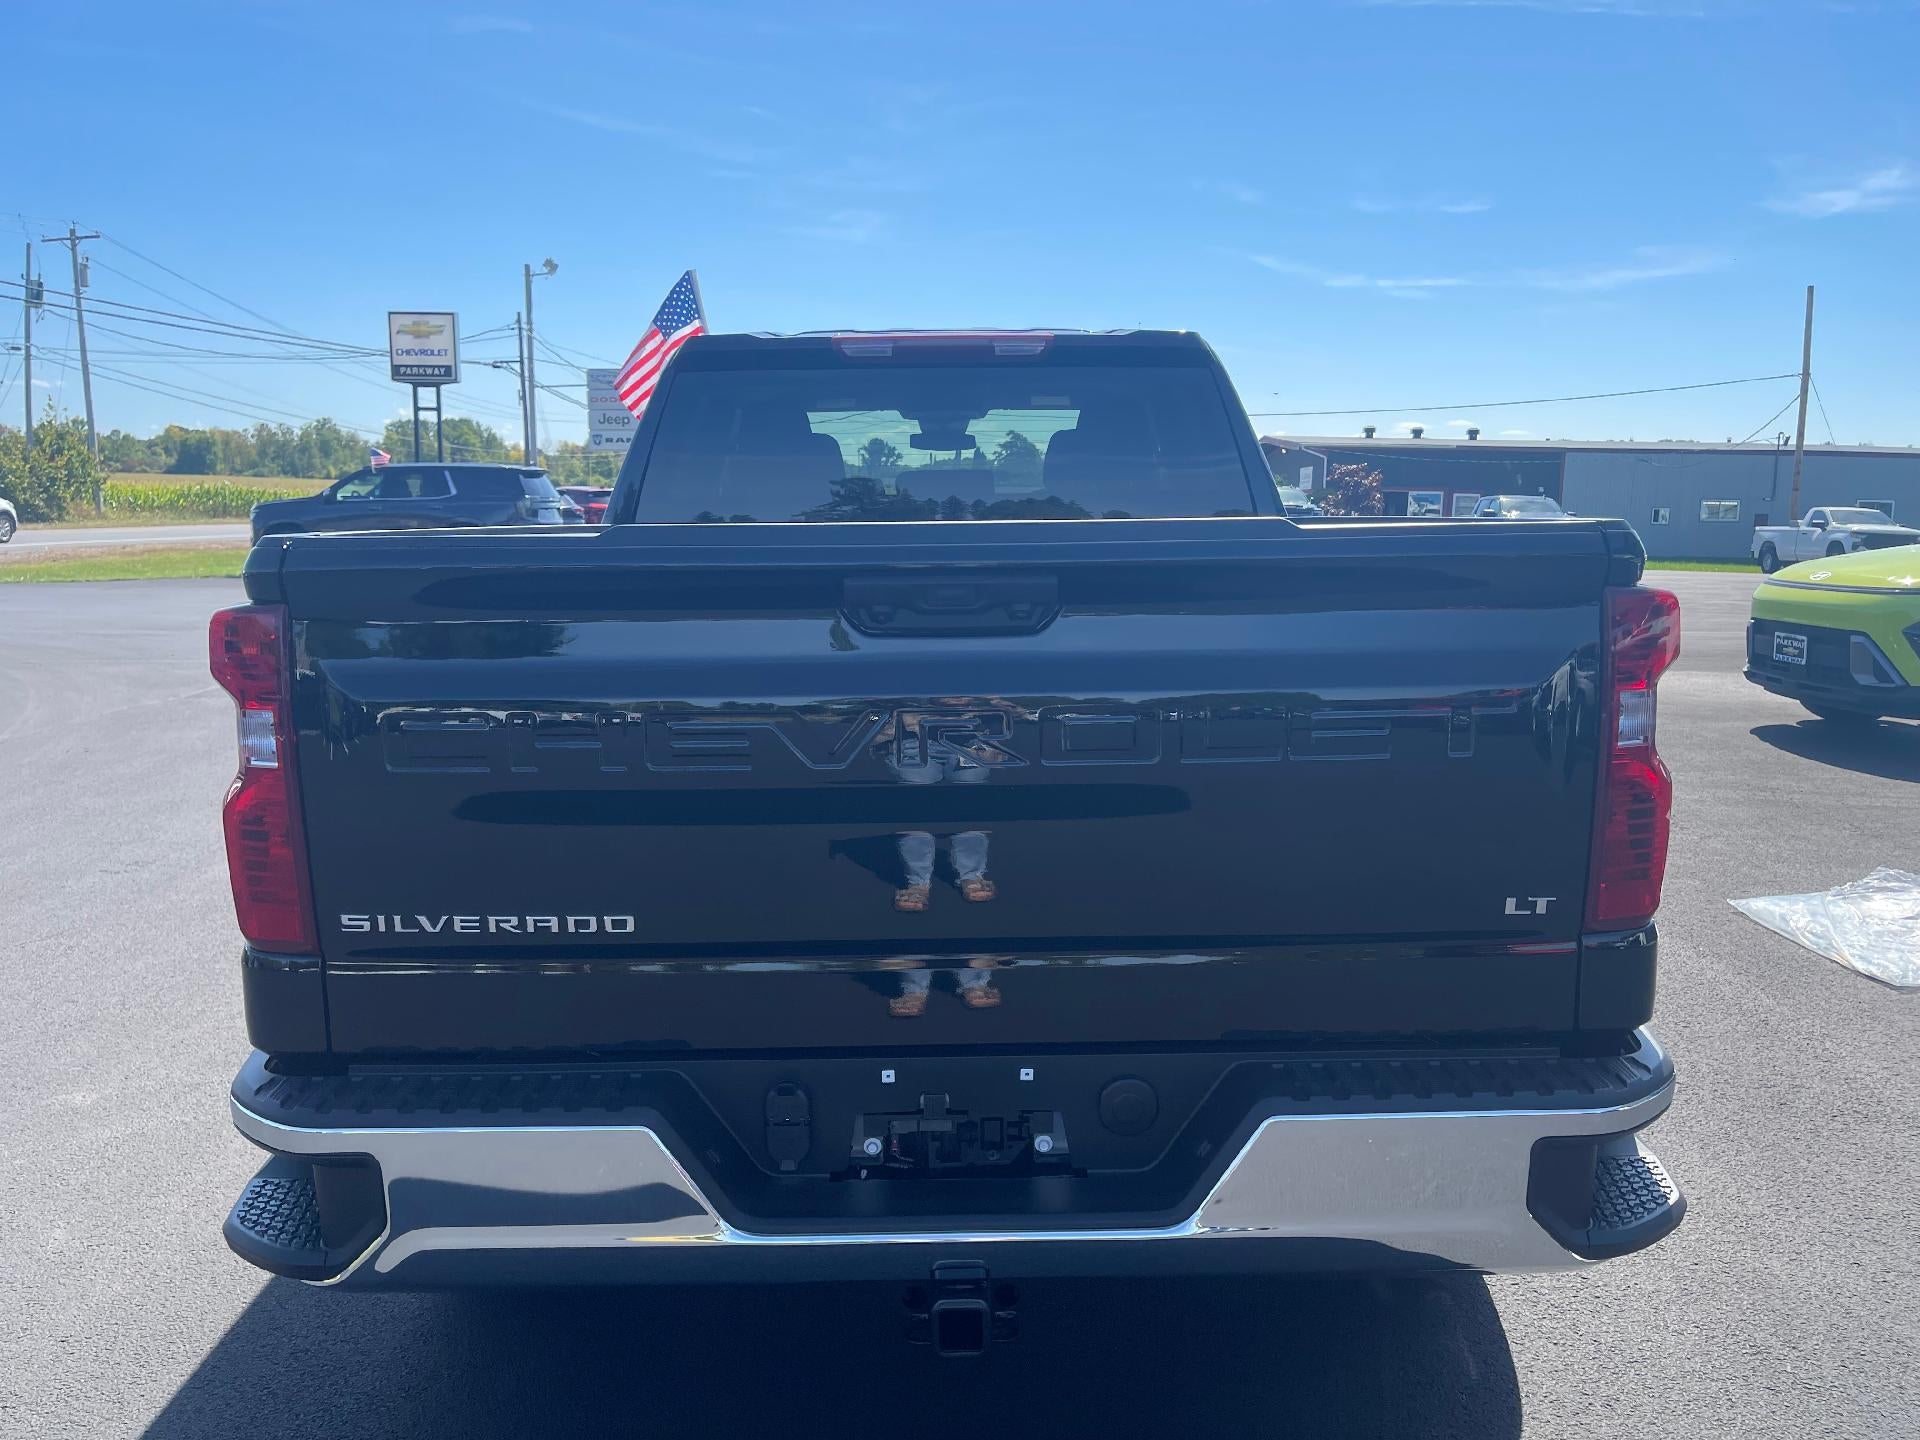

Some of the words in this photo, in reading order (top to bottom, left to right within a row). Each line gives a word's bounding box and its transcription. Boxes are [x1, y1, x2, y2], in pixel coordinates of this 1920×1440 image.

[395, 348, 449, 357] CHEVROLET
[400, 366, 446, 376] PARKWAY
[598, 413, 630, 427] Jeep
[376, 705, 1518, 773] CHEVROLET
[1504, 896, 1557, 915] LT
[340, 914, 636, 933] SILVERADO
